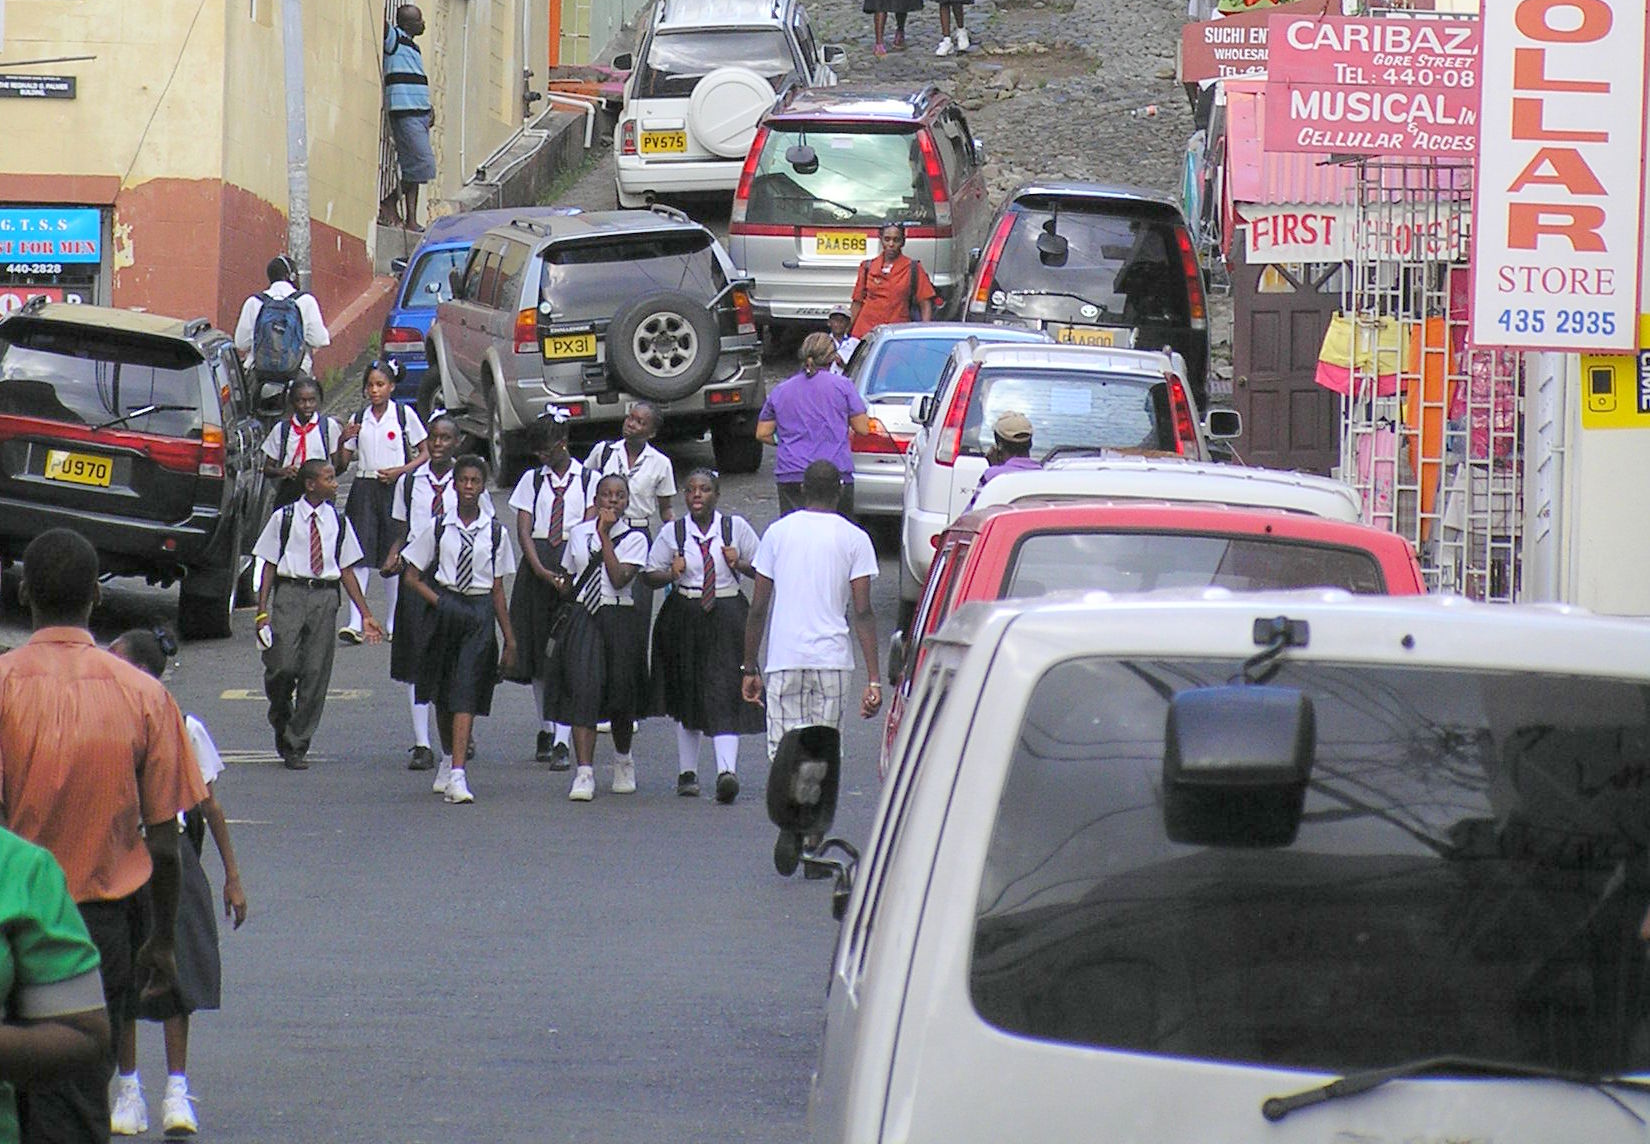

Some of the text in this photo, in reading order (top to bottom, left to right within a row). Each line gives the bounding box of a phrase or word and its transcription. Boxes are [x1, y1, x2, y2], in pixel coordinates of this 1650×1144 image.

[1204, 27, 1245, 43] SUCHI
[1287, 21, 1478, 55] CARIBAZ
[1373, 53, 1474, 68] GORE STREET
[1290, 89, 1476, 125] MUSICAL IN
[1297, 127, 1404, 148] CELLULAR
[1413, 132, 1475, 151] ACCES
[1251, 213, 1336, 252] FIRST
[20, 240, 54, 254] FOR
[60, 240, 96, 254] MEN
[817, 237, 867, 251] PAA689
[6, 263, 62, 274] 440-2828
[1498, 266, 1615, 295] STORE
[1498, 309, 1616, 336] 435 2935
[553, 338, 589, 354] PX31
